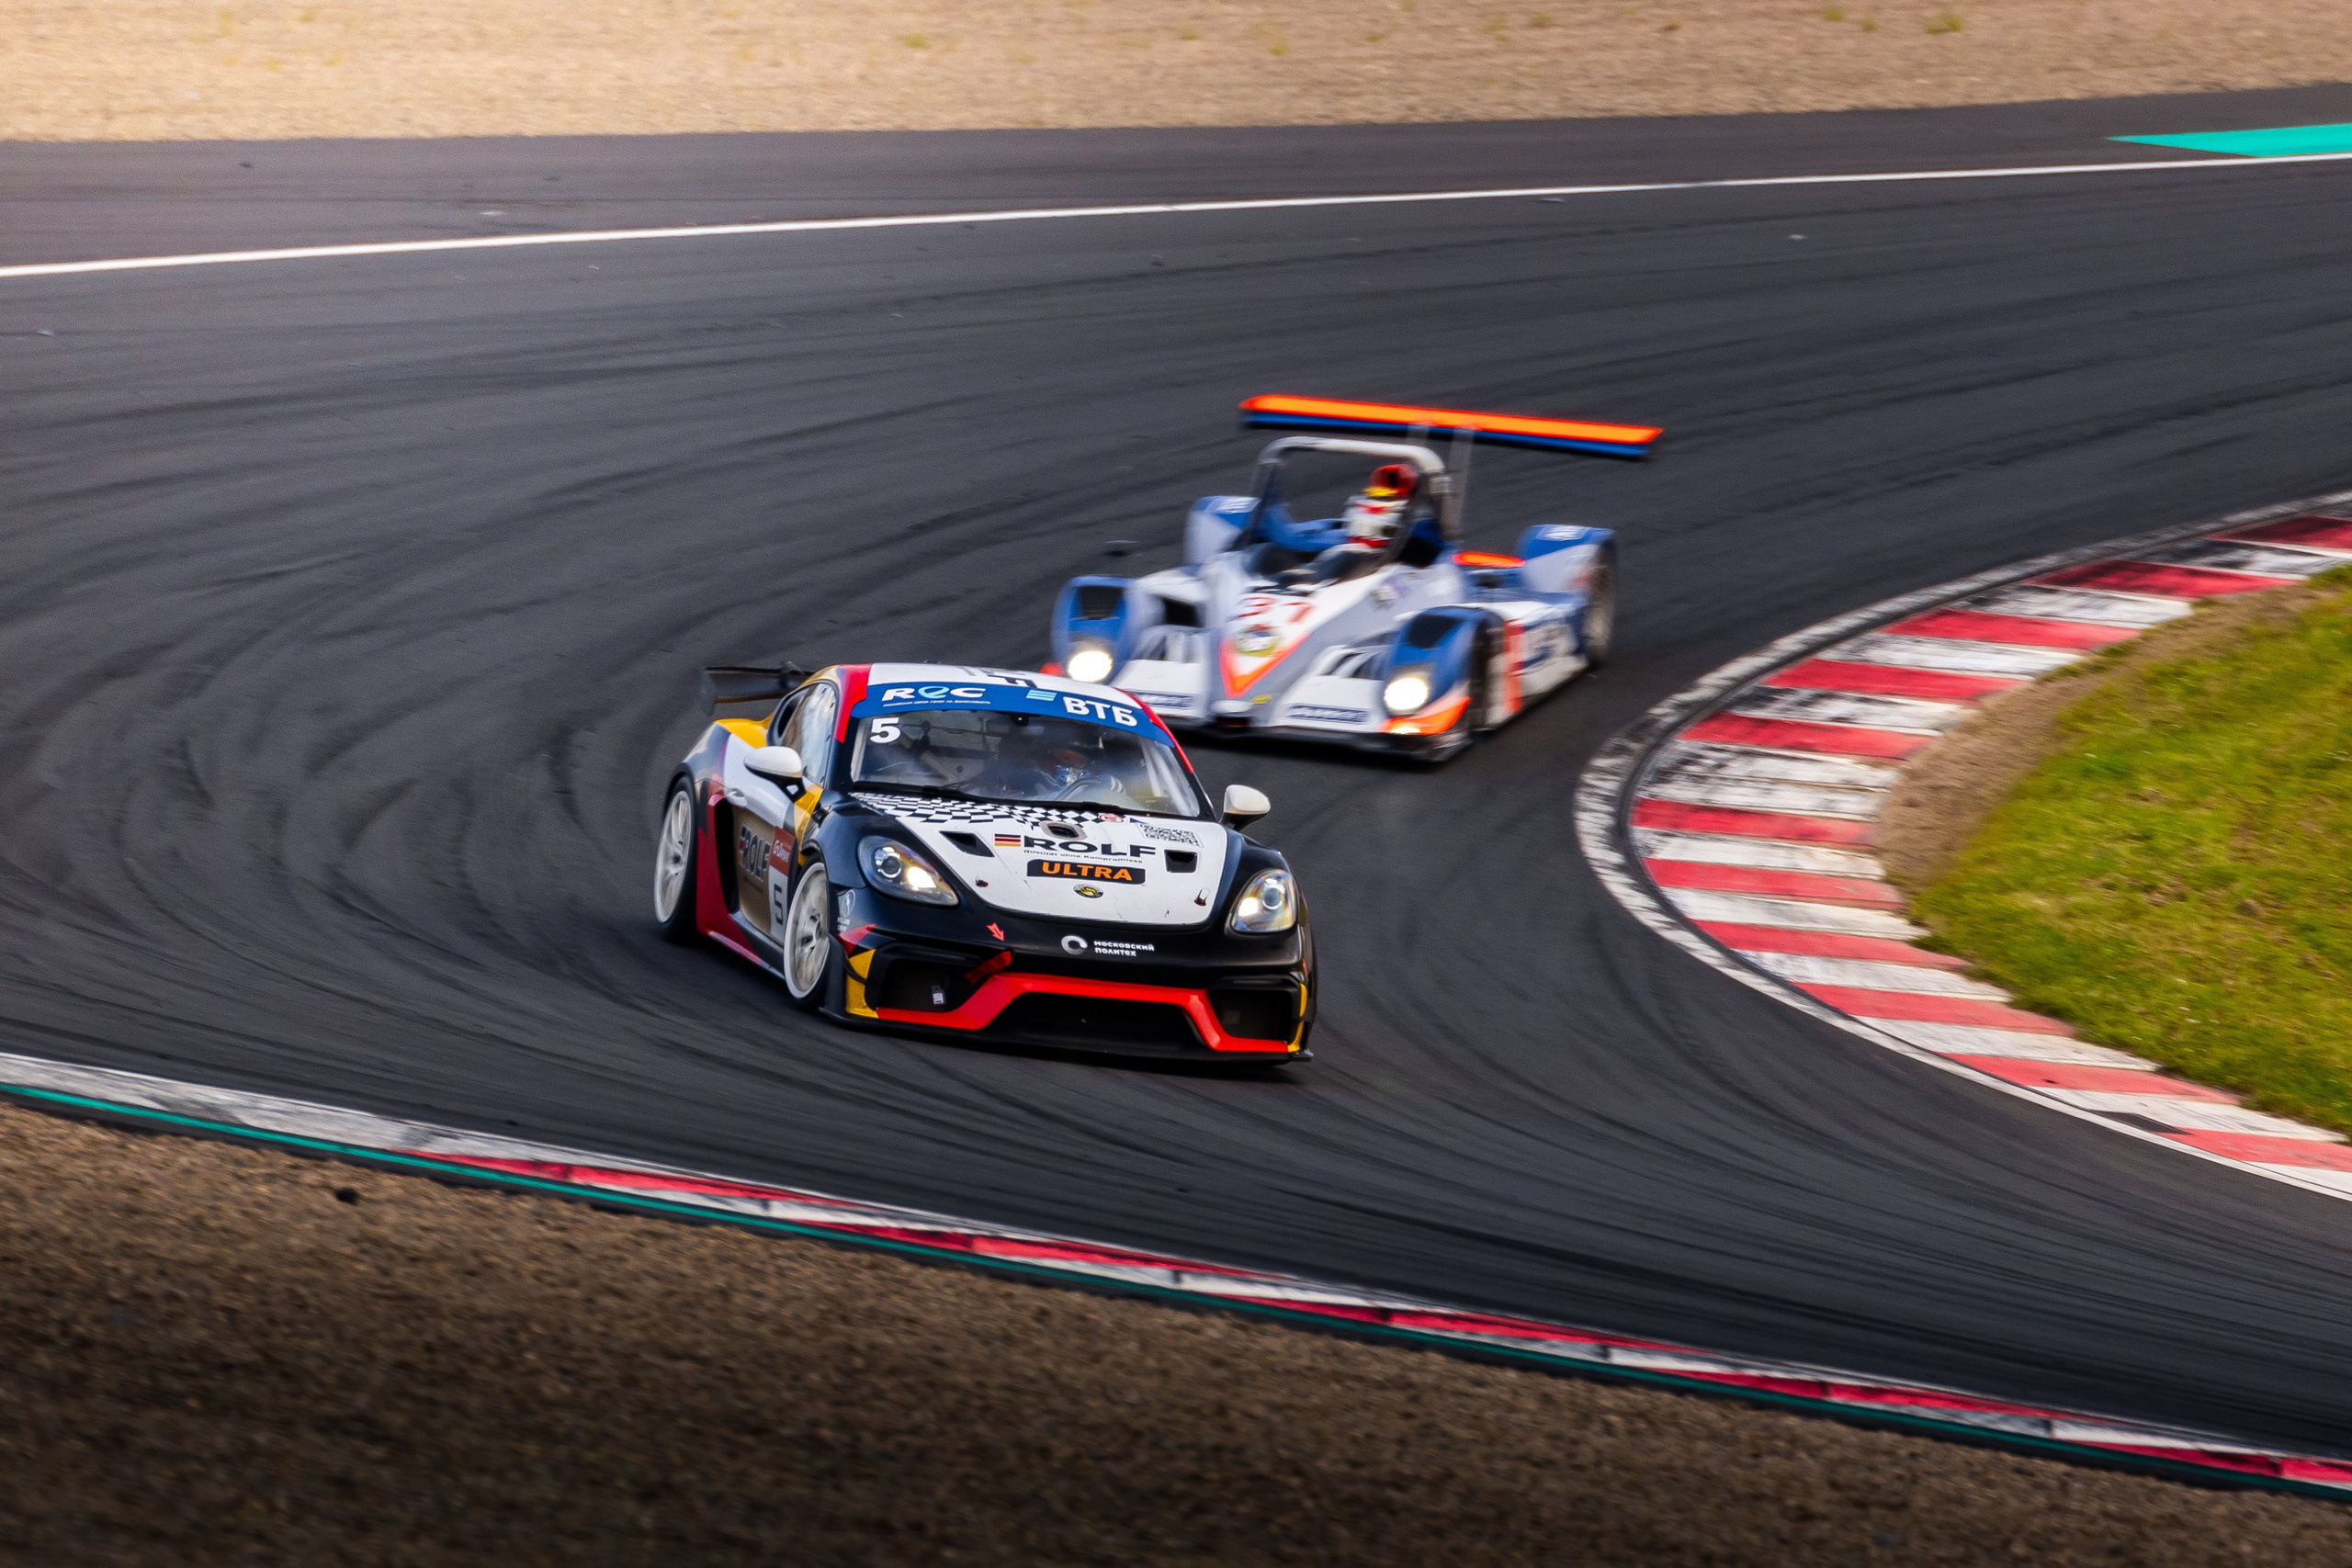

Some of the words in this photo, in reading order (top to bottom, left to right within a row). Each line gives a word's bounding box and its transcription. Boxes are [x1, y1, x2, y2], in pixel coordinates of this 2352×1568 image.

[1062, 696, 1138, 728] ВТБ
[869, 717, 901, 744] 5
[1023, 835, 1156, 858] ROLF
[1042, 862, 1133, 882] ULTRA
[774, 883, 784, 926] 5
